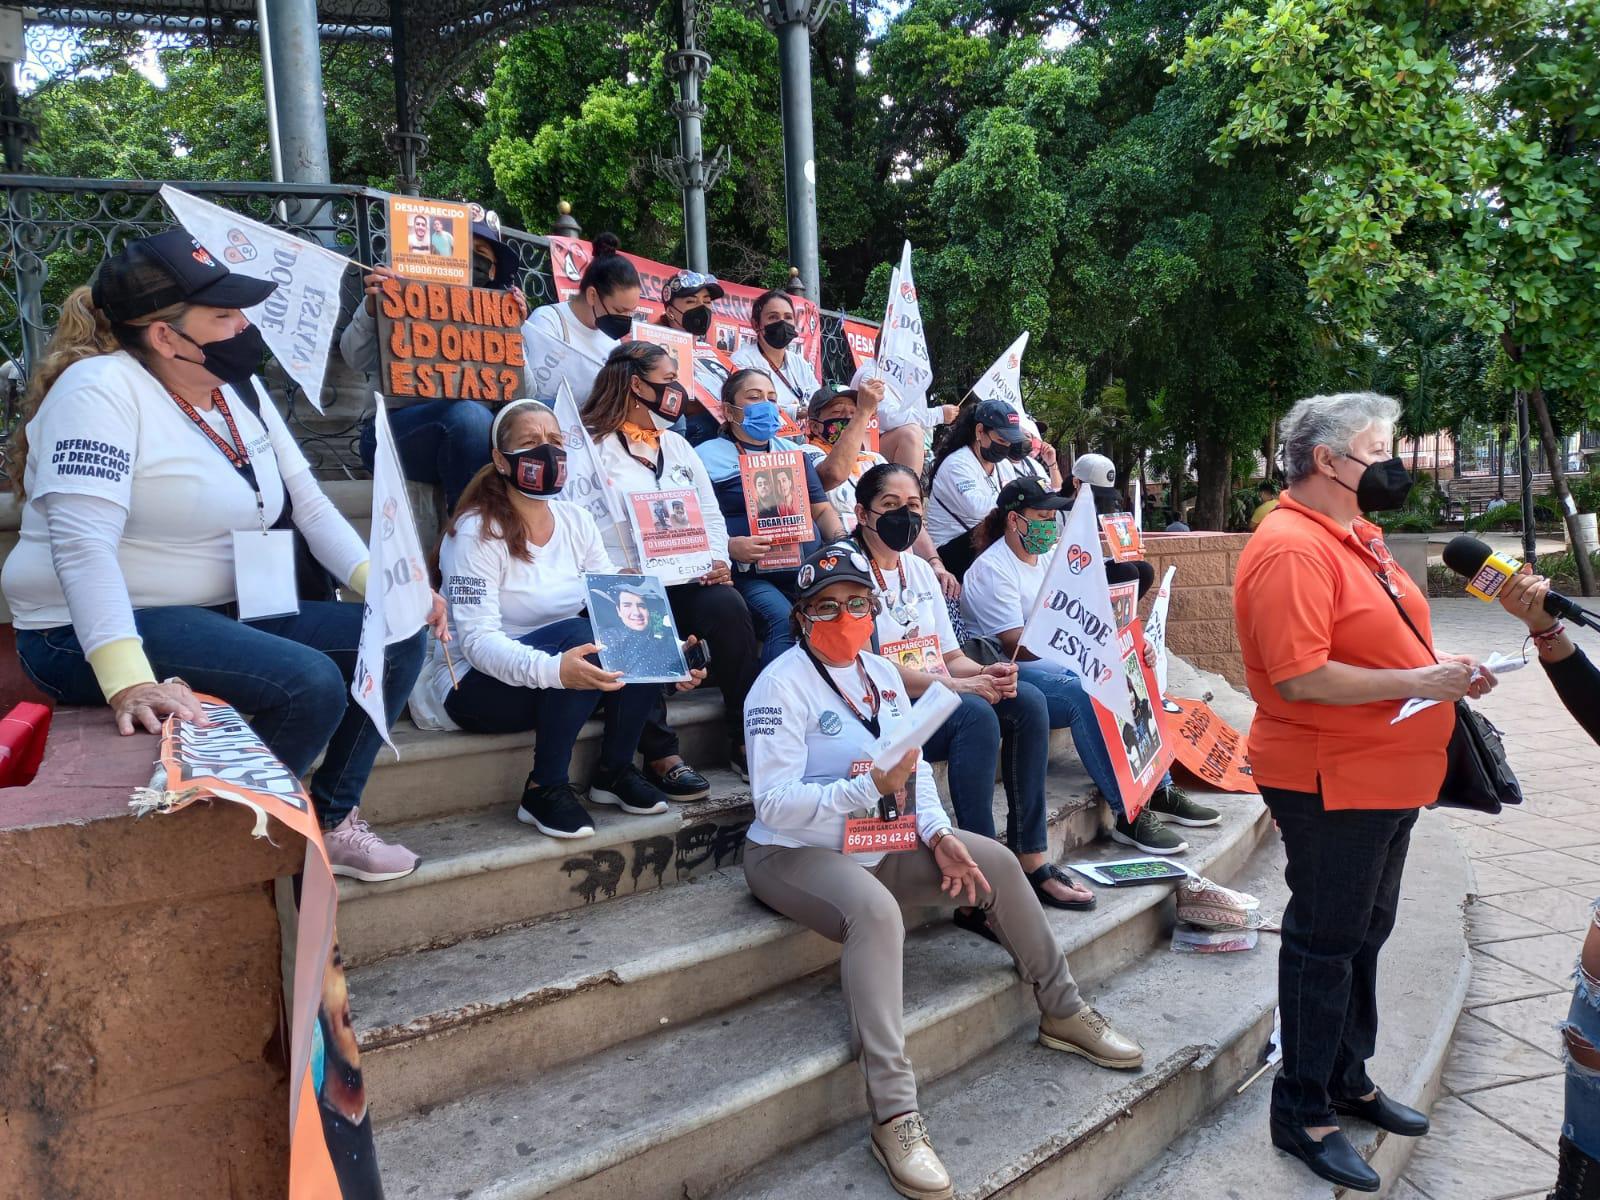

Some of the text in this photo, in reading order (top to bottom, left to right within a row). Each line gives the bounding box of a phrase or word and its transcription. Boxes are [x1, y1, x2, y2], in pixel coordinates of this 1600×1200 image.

[394, 203, 465, 218] DESAPARECIDO
[382, 278, 521, 328] SOBRINO
[391, 322, 525, 367] ¿DONDE
[390, 362, 519, 400] ESTAS?
[200, 421, 237, 460] SABUESOS
[56, 439, 131, 463] DEFENSORAS
[52, 451, 130, 475] DE DERECHOS
[747, 454, 797, 468] JUSTICIA
[57, 464, 121, 482] HUMANOS
[634, 490, 692, 501] DESAPARECIDO
[758, 515, 806, 529] EDGAR FELIPE
[1472, 566, 1499, 592] MEGA
[1043, 589, 1113, 647] ¿DÓNDE
[883, 639, 935, 655] DESAPARECIDO
[747, 706, 782, 717] DEFENSORAS
[752, 717, 783, 727] DERECHOS
[849, 824, 876, 834] YOSIMAR
[899, 822, 915, 830] CRUZ
[848, 831, 916, 846] 6673 29 42 49
